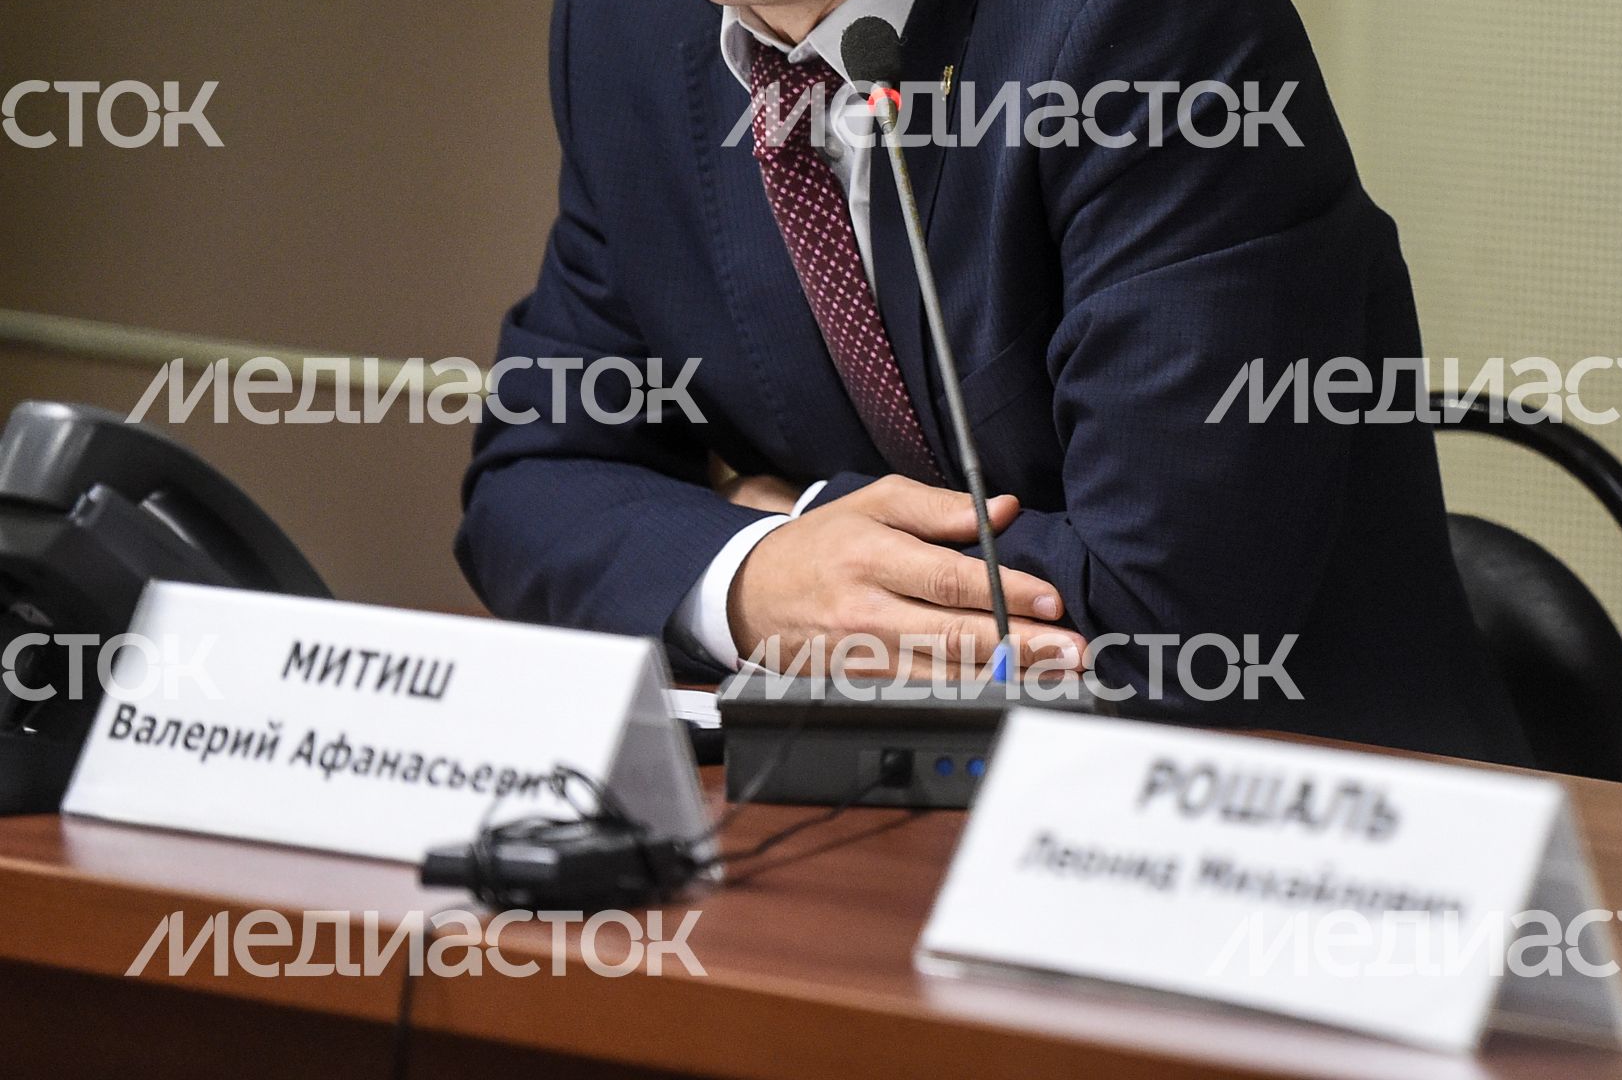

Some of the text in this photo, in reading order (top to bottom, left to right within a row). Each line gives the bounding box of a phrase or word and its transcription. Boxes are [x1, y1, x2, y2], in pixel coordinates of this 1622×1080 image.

[281, 640, 457, 702] МИТИШ
[109, 704, 284, 766] Валерий
[1136, 756, 1404, 844] РОШАЛЬ
